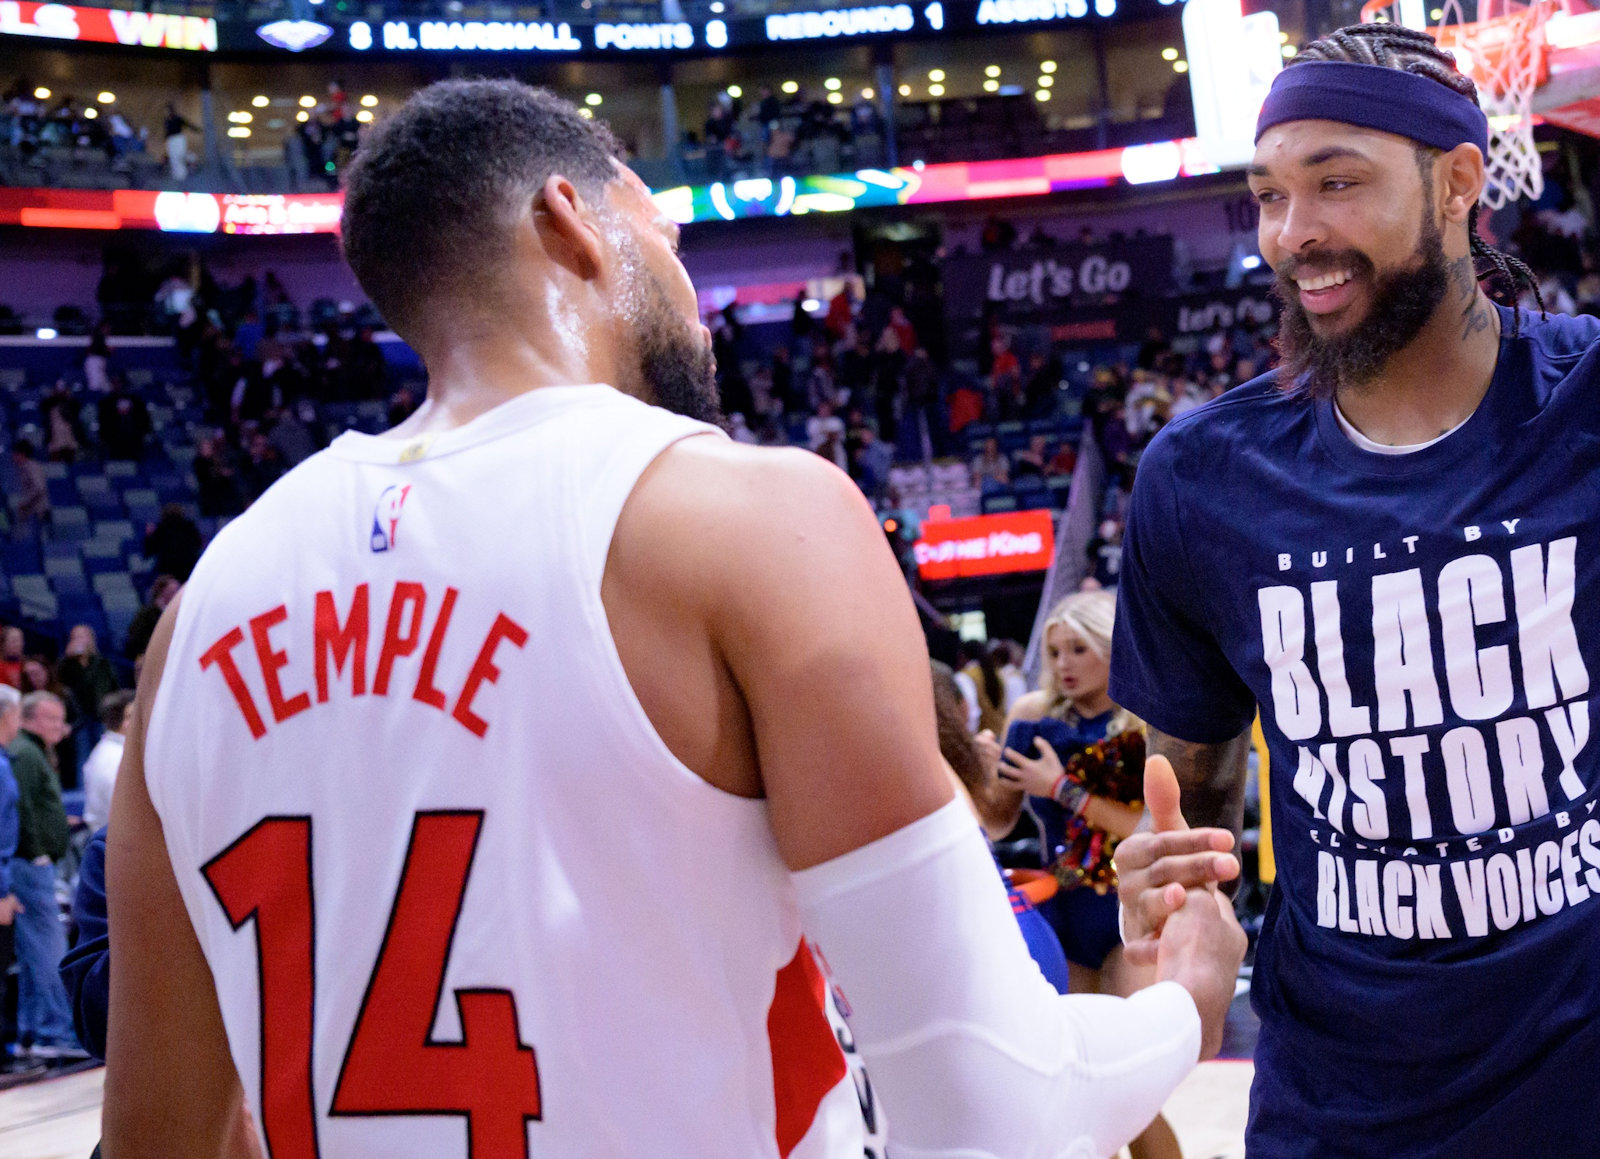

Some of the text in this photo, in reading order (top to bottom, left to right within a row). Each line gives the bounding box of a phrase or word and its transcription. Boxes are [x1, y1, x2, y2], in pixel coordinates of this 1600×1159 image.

[109, 9, 218, 51] WIN
[594, 23, 695, 50] POINTS
[765, 4, 914, 41] REBOUNDS
[924, 2, 944, 30] 1
[988, 255, 1131, 305] Let's Go
[1277, 518, 1520, 571] BUILT BY
[199, 580, 530, 741] TEMPLE
[1258, 536, 1590, 740] BLACK
[1293, 700, 1590, 840] HISTORY
[1317, 818, 1600, 940] BLACK VOICES
[199, 809, 543, 1159] 14
